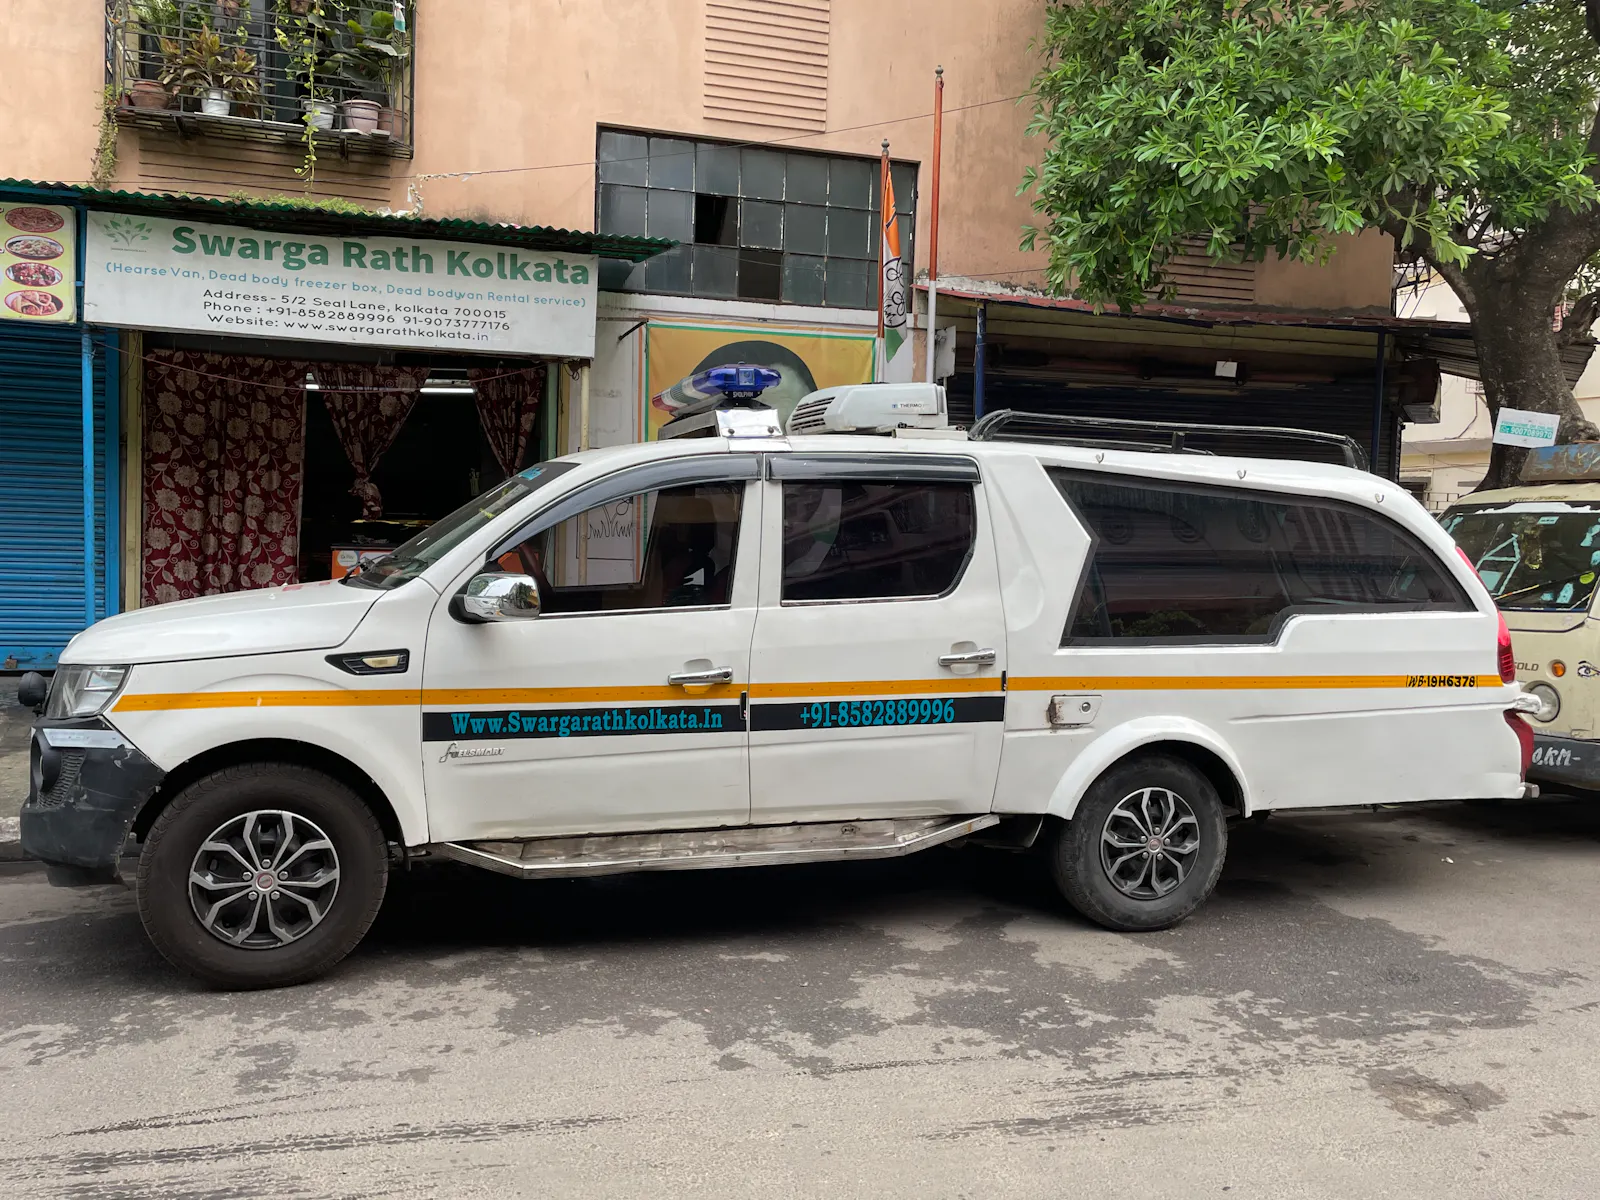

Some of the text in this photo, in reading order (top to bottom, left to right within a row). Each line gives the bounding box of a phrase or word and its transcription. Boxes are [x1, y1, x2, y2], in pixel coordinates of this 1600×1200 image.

[172, 226, 589, 285] Swarga Rath Kolkata
[106, 262, 167, 276] (Hearse
[170, 266, 205, 280] Van,
[208, 269, 247, 282] Dead
[252, 273, 288, 287] body
[294, 277, 347, 290] freezer
[352, 282, 382, 294] box,
[386, 284, 422, 296] Dead
[487, 291, 530, 304] Rental
[533, 296, 587, 308] service)
[266, 307, 395, 323] +91-8582889996
[403, 316, 510, 331] 91-9073777176
[281, 295, 306, 305] 5/2
[313, 297, 346, 308] Seal
[350, 301, 390, 312] Lane,
[395, 304, 449, 315] kolkata
[454, 308, 506, 319] 700015
[207, 314, 489, 341] Website: www.swargarathkolkata.in
[451, 708, 723, 737] Www.Swargarathkolkata.In
[800, 699, 955, 727] +91-8582889996
